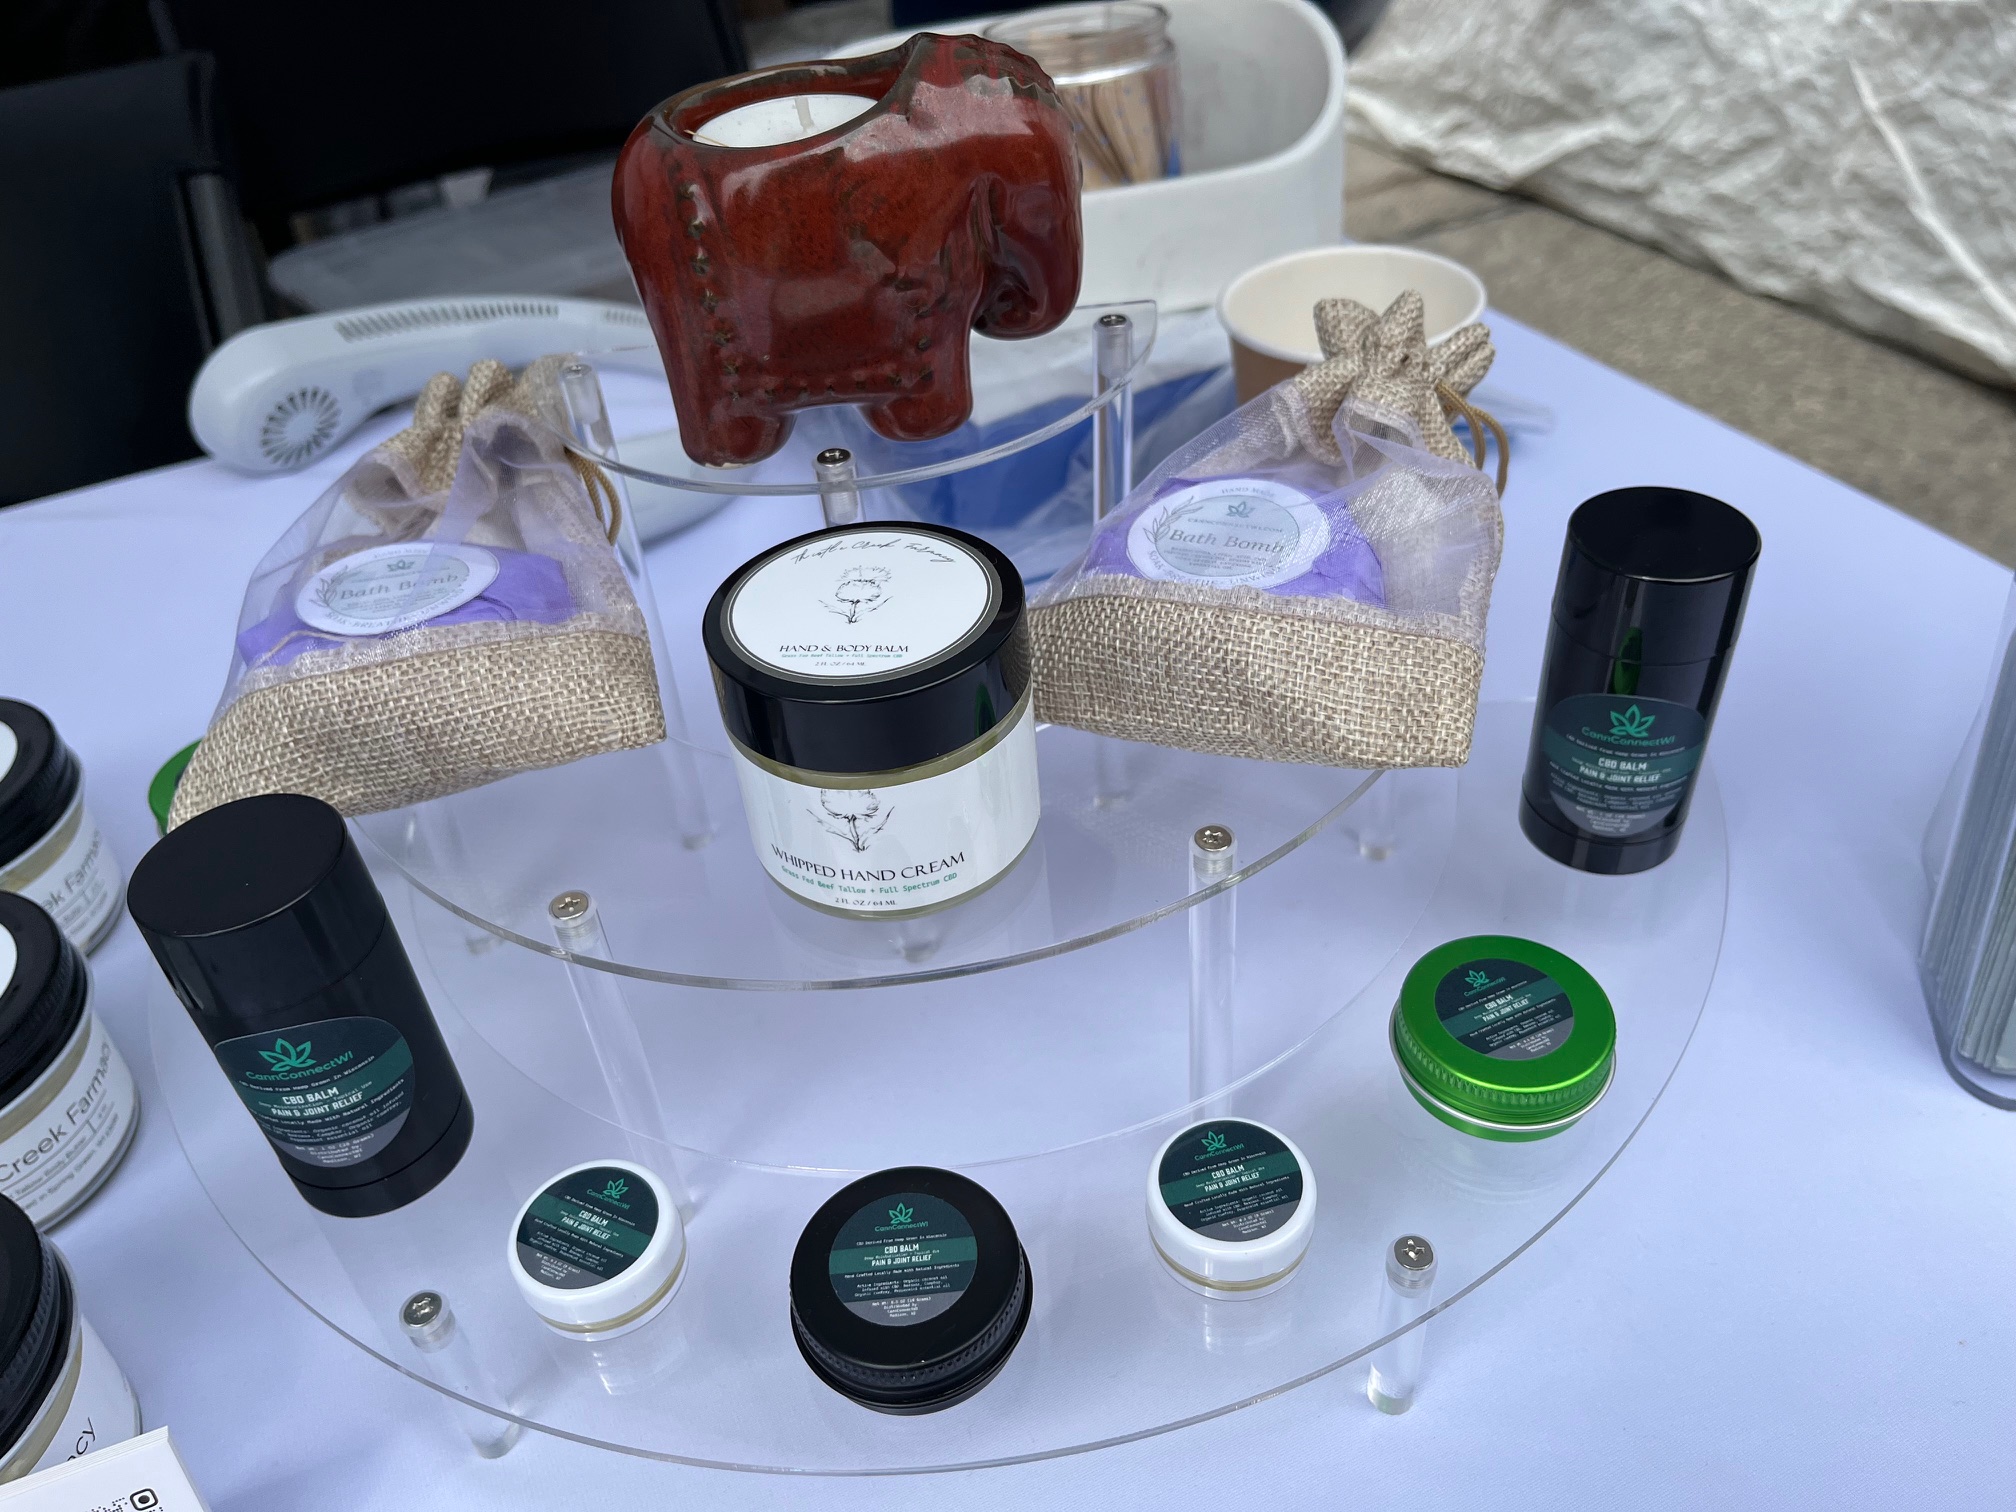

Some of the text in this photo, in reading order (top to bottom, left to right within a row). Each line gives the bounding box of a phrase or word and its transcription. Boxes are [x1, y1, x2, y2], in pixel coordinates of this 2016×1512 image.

[1170, 529, 1285, 553] Bath Bomb
[341, 585, 389, 599] Bath
[779, 644, 909, 653] HAND & BODY BALM
[1581, 726, 1675, 747] CannConnectWI
[1598, 757, 1648, 771] CBD BALM
[1579, 765, 1661, 784] PAIN & JOINT RELIEF
[771, 843, 965, 882] WHIPPED HAND CREAM
[781, 865, 799, 879] Grass
[802, 875, 815, 885] Fed
[817, 880, 834, 890] Beef
[838, 885, 866, 893] Tallow
[879, 886, 898, 894] Full
[903, 879, 940, 893] Spectrum
[943, 872, 958, 882] CBD
[1482, 1013, 1496, 1022] PAIN
[1500, 1005, 1514, 1015] JOINT
[1512, 998, 1529, 1009] RELIEF
[1484, 994, 1514, 1010] CBD BALM
[245, 1050, 353, 1081] CannConnectWI
[343, 1055, 375, 1076] Wisconsin
[271, 1091, 363, 1117] PAIN & JOINT RELIEF
[282, 1086, 339, 1105] CBD BALM
[1194, 1143, 1244, 1161] CannConnectWI
[1211, 1164, 1245, 1179] CBD BALM
[1204, 1183, 1219, 1192] PAIN
[1224, 1177, 1240, 1187] JOINT
[1241, 1171, 1259, 1182] RELIEF
[579, 1210, 609, 1227] CBD BALM
[874, 1221, 929, 1232] CannConnectWI
[561, 1217, 575, 1226] PAIN
[578, 1223, 594, 1233] JOINT
[592, 1229, 611, 1240] RELIEF
[884, 1243, 919, 1254] CBD BALM
[871, 1259, 886, 1267] PAIN
[893, 1256, 910, 1264] JOINT
[911, 1254, 932, 1262] RELIEF
